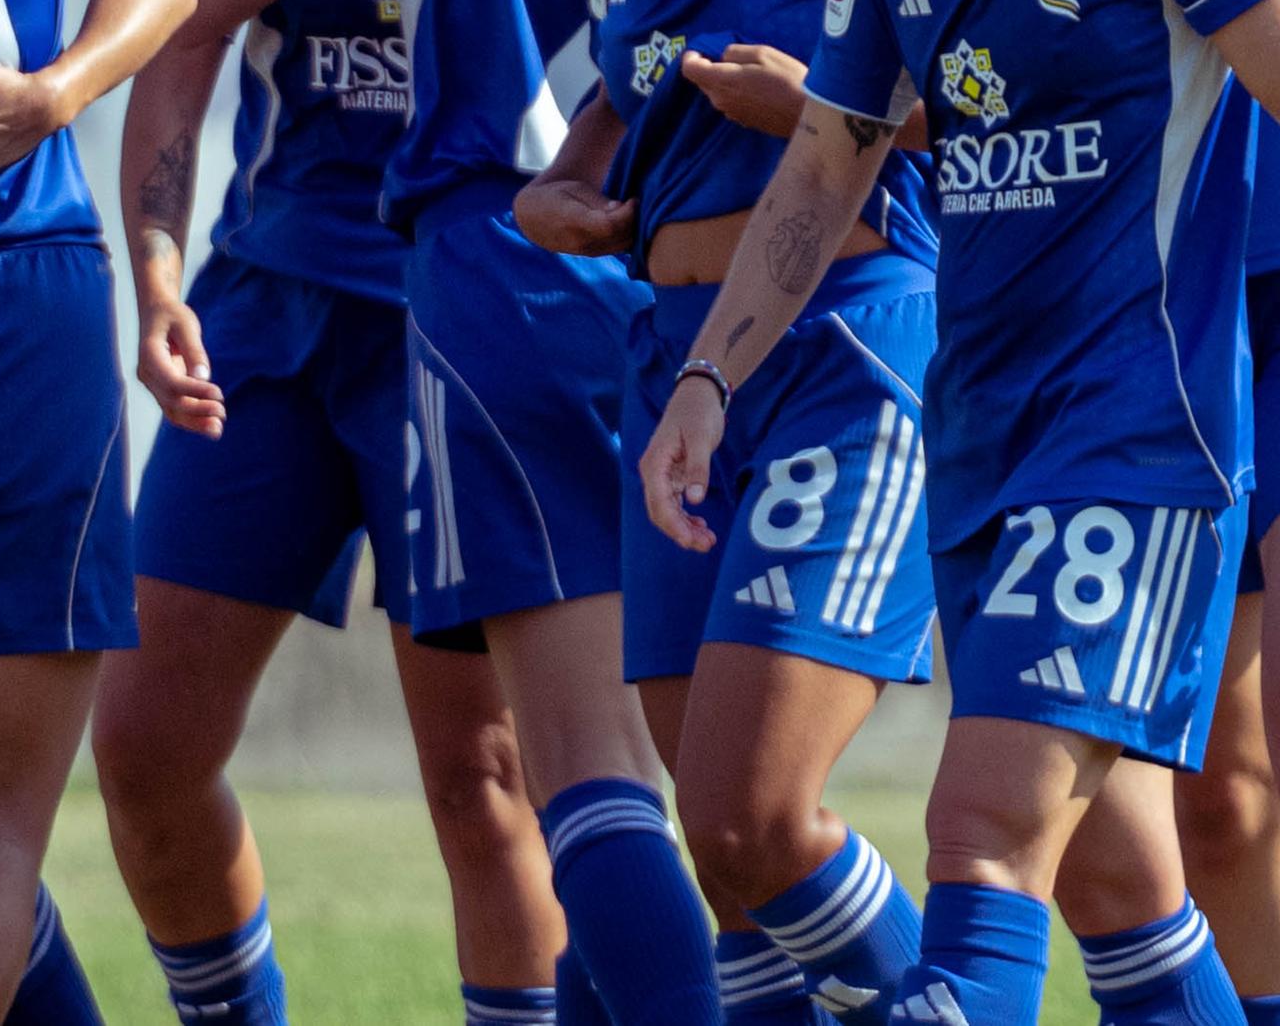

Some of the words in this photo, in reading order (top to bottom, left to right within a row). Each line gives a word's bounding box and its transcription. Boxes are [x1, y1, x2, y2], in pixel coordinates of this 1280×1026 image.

[341, 89, 408, 112] MATERIA
[969, 190, 992, 213] CHE
[994, 186, 1056, 212] ARREDA
[749, 445, 838, 550] 8
[982, 505, 1135, 625] 28
